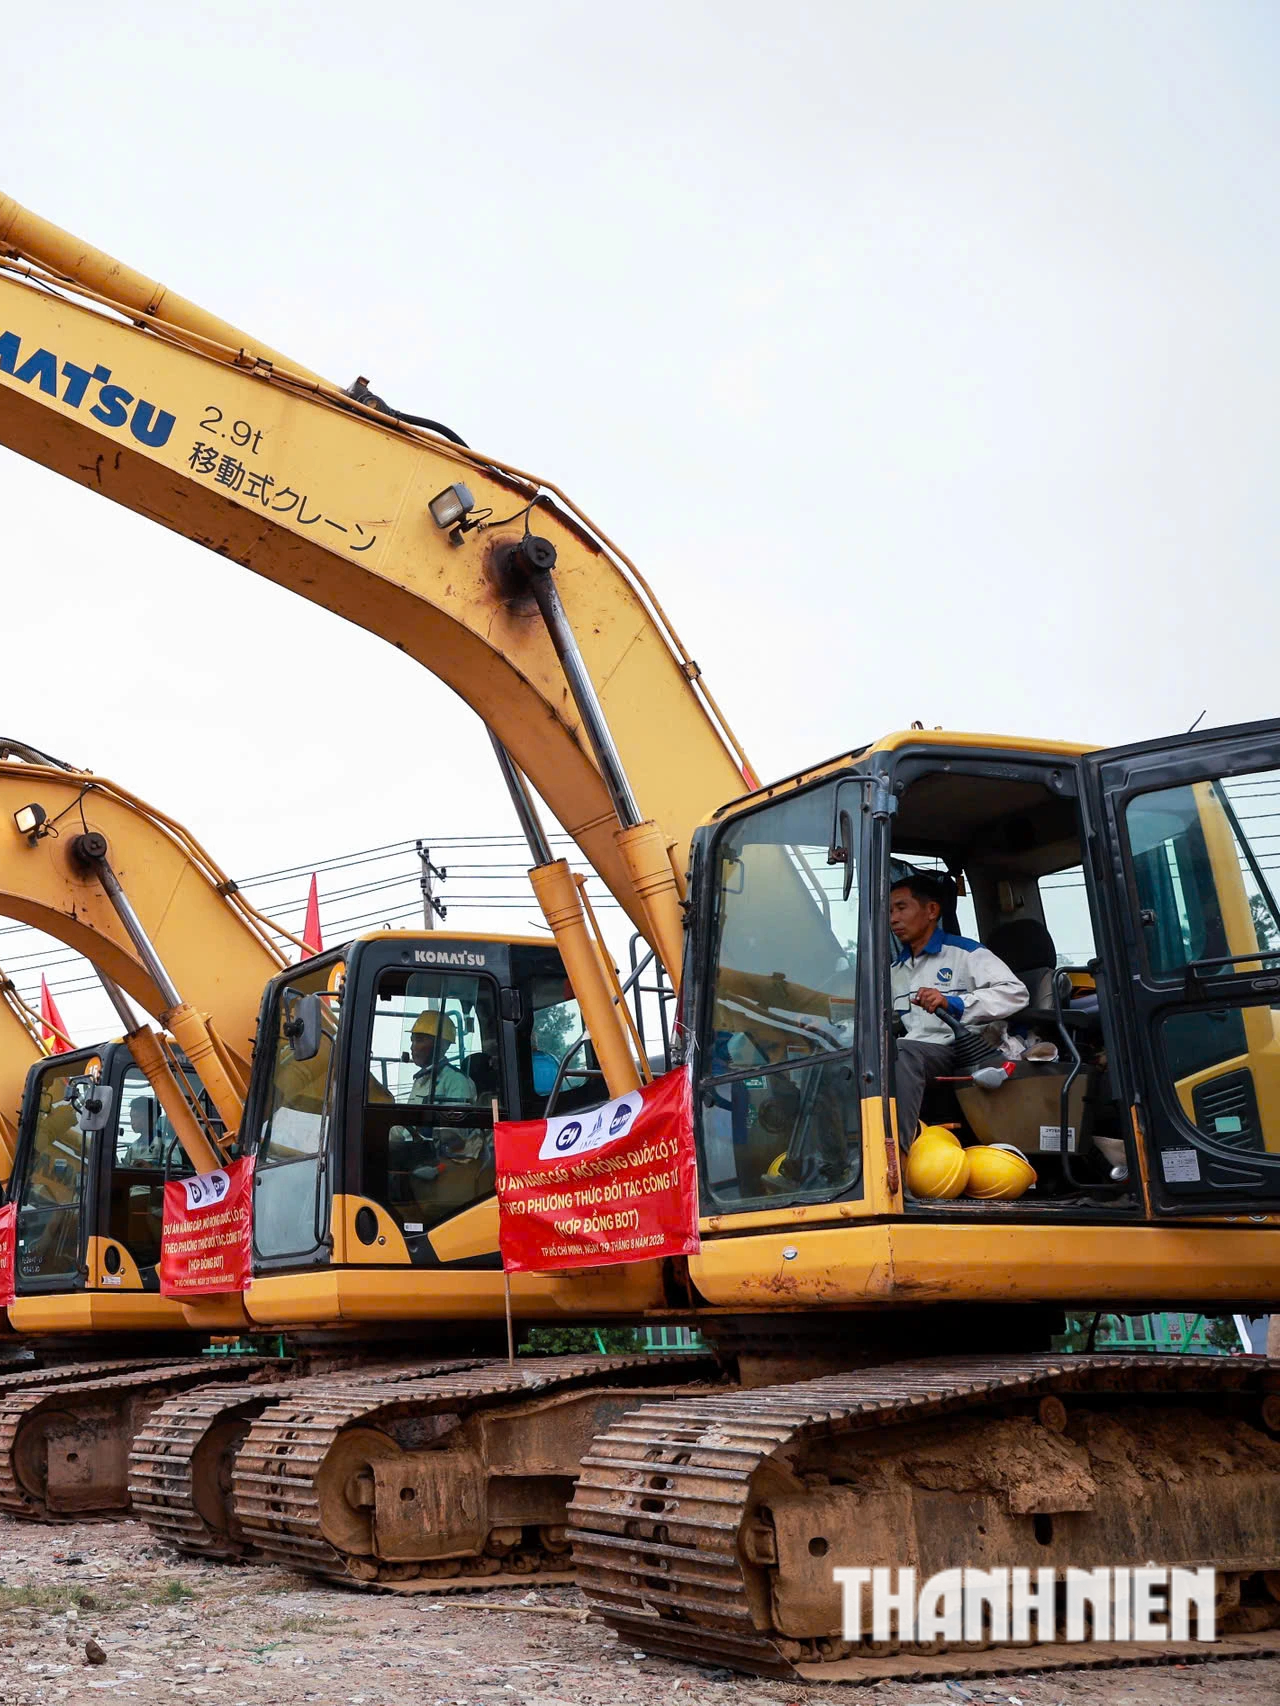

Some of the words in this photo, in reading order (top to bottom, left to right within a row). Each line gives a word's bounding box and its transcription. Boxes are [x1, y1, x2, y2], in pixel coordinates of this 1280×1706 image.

[199, 405, 265, 455] 2.9t
[187, 440, 377, 552] 移動式クレーン
[414, 950, 486, 966] KOMATSU
[527, 1193, 573, 1214] PHƯƠNG
[574, 1185, 603, 1205] THỨC
[604, 1175, 622, 1201] ĐỐI
[624, 1176, 642, 1197] TÁC
[642, 1172, 670, 1192] CÔNG
[583, 1209, 614, 1234] ĐỒNG
[615, 1208, 639, 1231] BOT)
